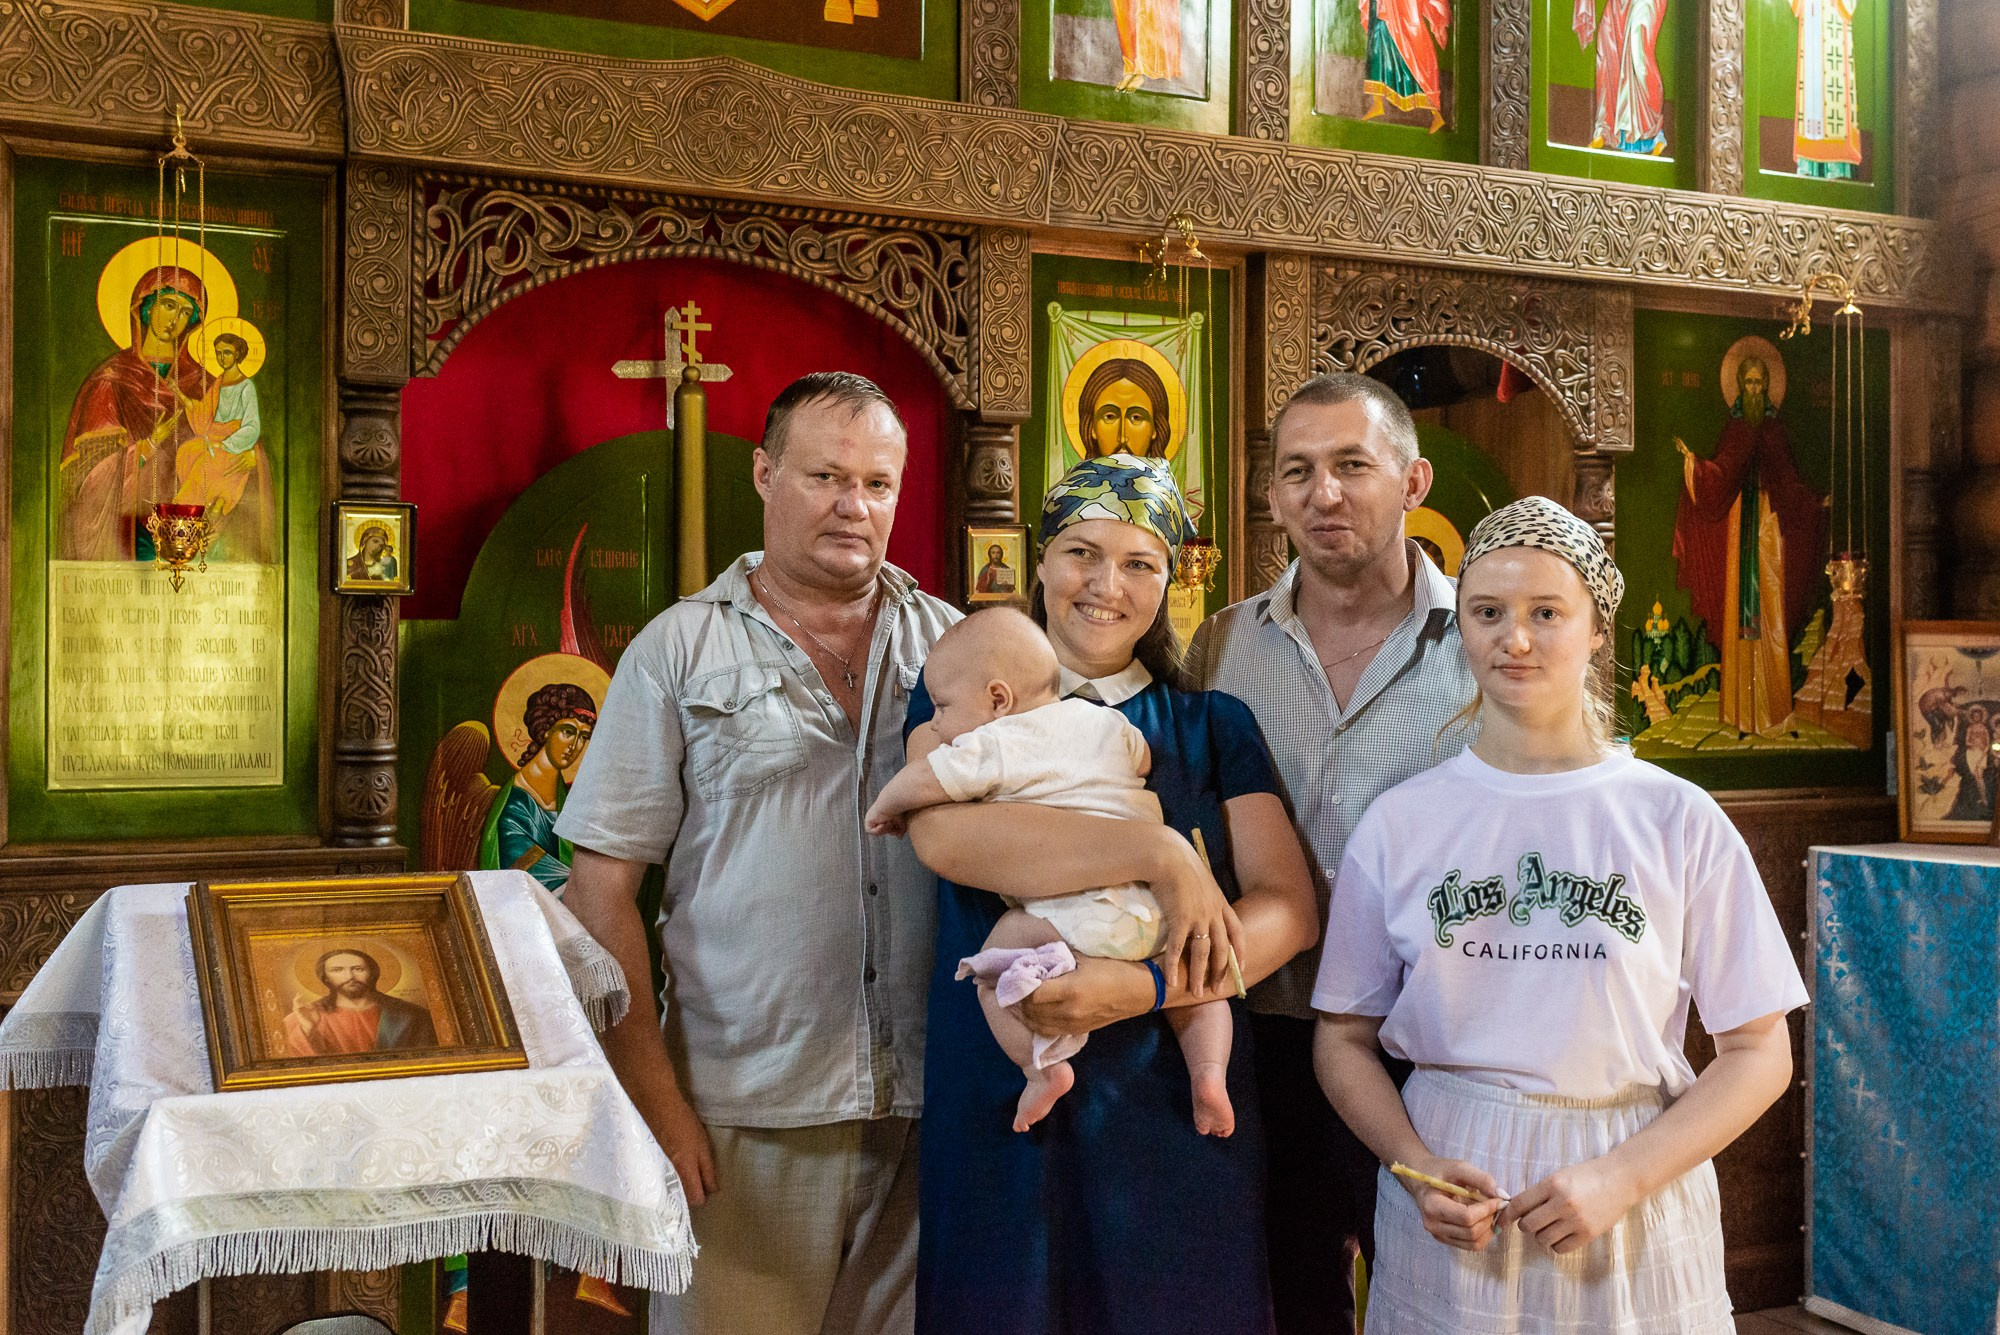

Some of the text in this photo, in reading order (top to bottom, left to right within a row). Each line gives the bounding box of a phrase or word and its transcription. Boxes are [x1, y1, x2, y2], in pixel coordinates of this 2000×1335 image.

[1427, 851, 1647, 948] Los Angeles
[1462, 941, 1608, 960] CALIFORNIA
